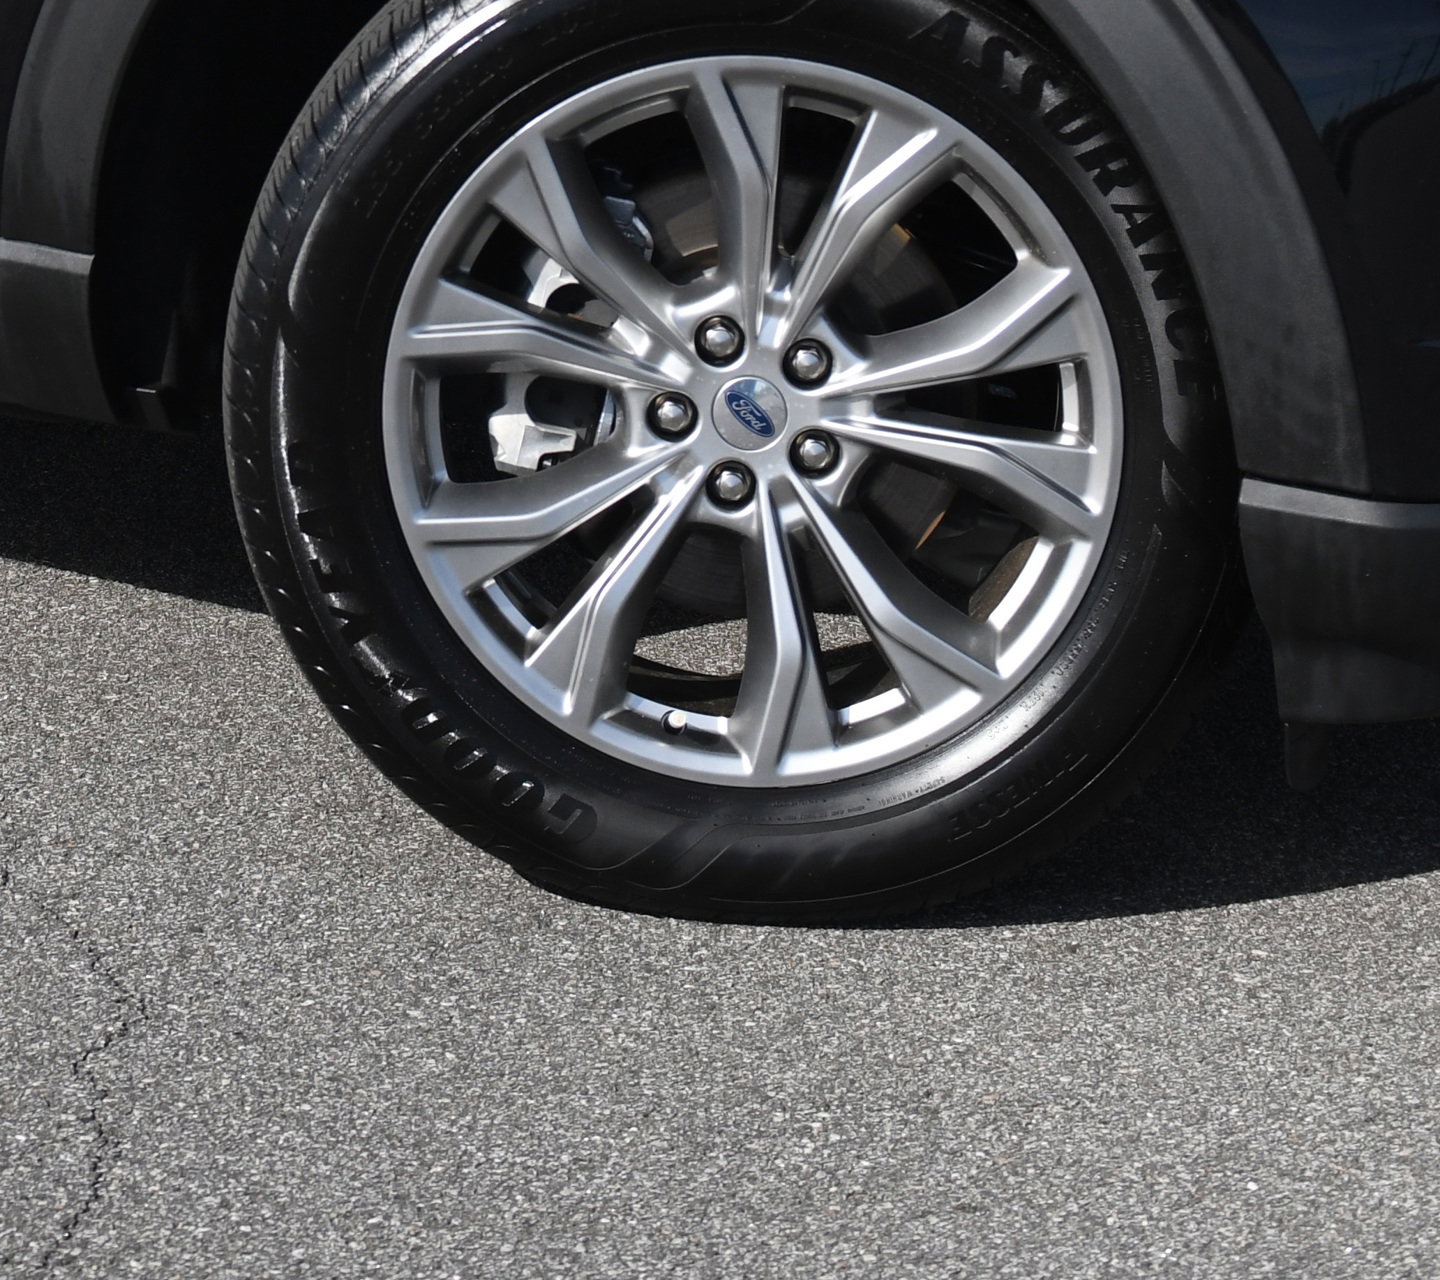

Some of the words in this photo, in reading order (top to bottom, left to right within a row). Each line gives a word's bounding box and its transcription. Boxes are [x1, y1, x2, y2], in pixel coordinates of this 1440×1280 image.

[909, 7, 1219, 401] ASSURANCE
[731, 399, 767, 431] Ford
[292, 435, 601, 847] GOODYEAR
